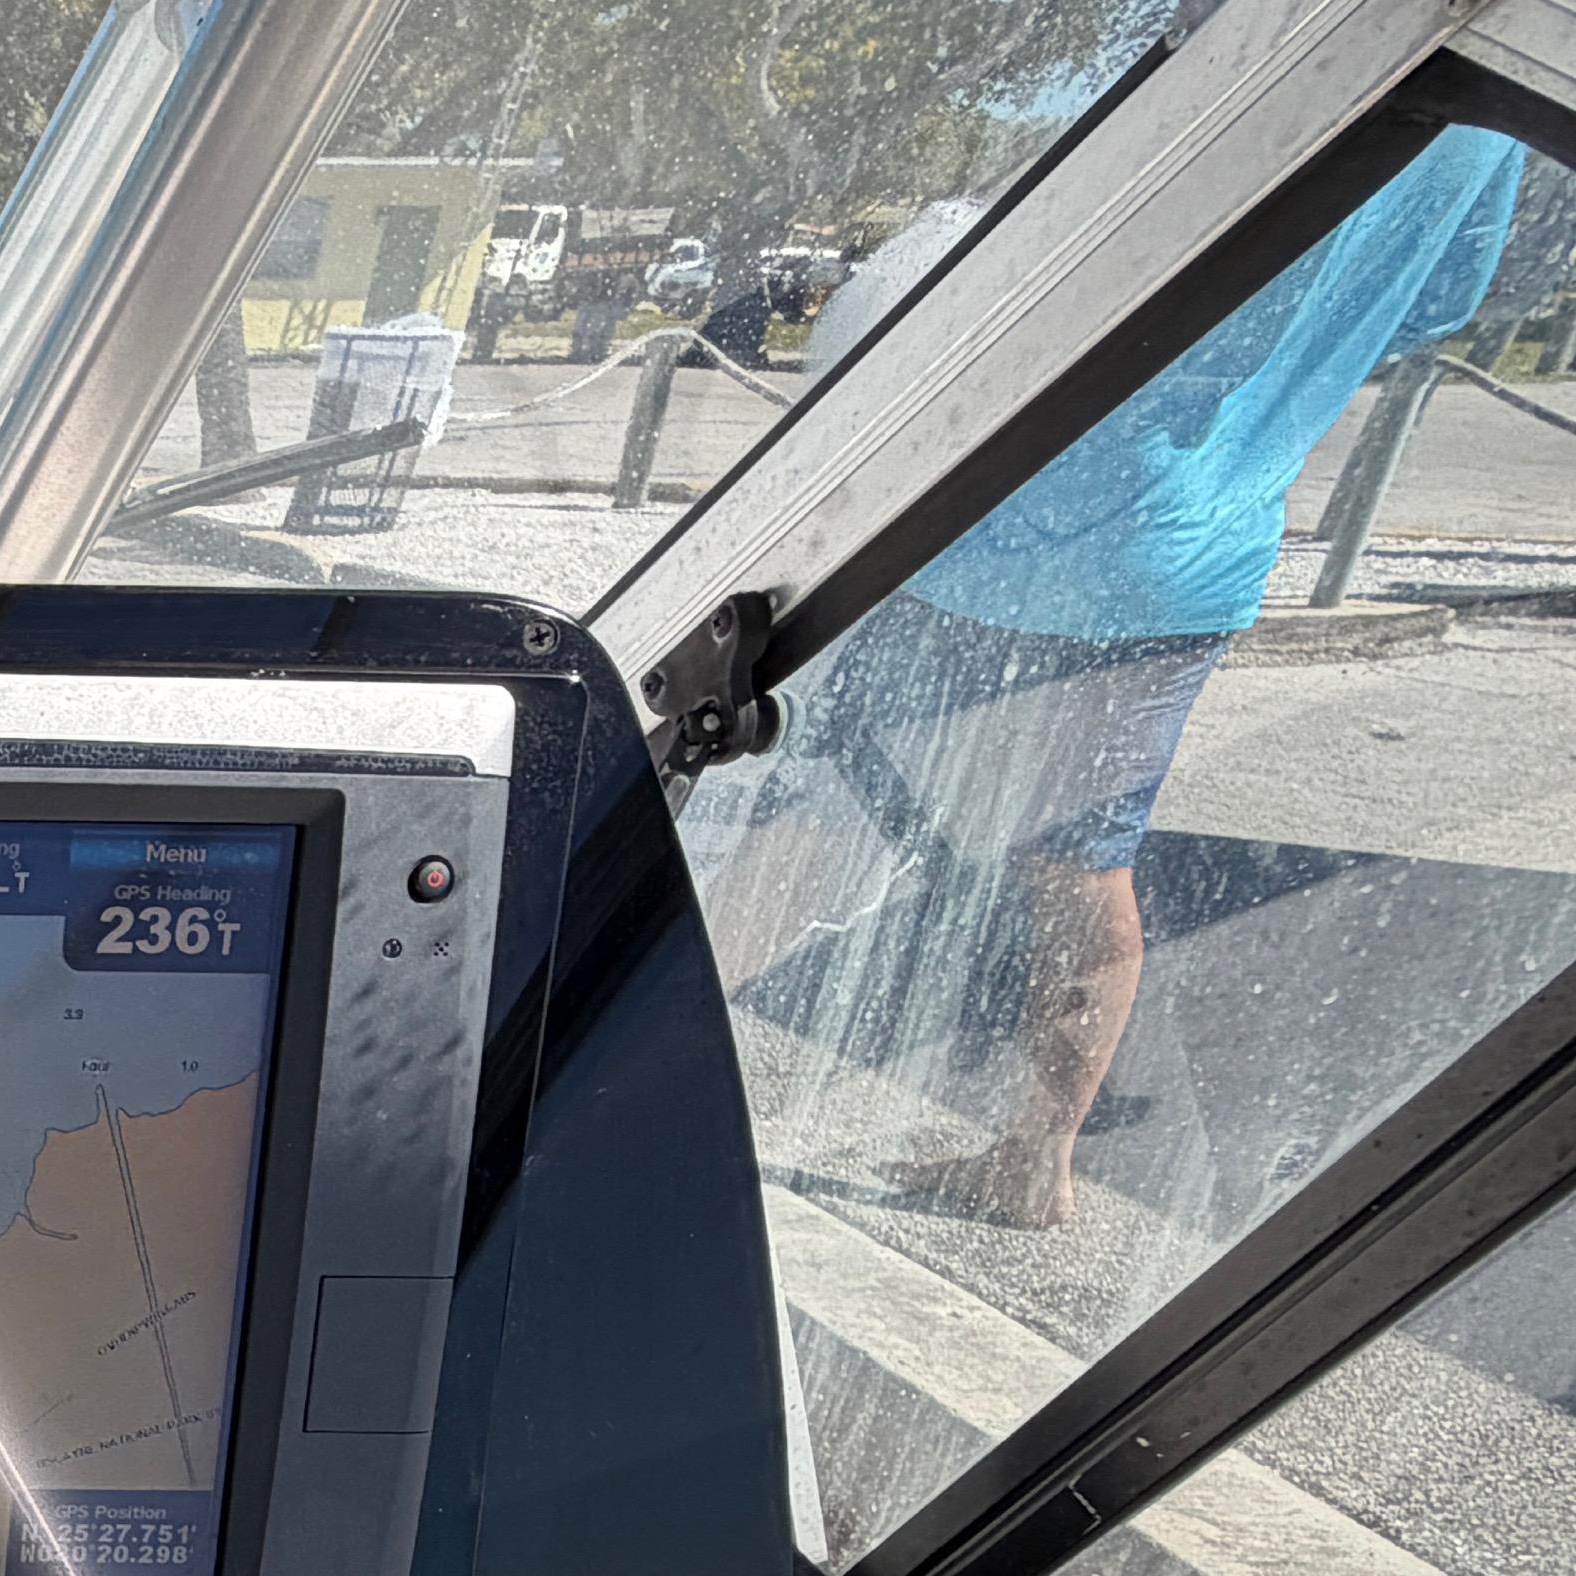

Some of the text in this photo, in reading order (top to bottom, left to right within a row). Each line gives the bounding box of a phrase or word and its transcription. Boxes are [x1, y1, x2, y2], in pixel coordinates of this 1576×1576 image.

[146, 843, 207, 864] Menu
[113, 884, 232, 906] GPS Heading
[55, 1504, 168, 1521] GPS Position
